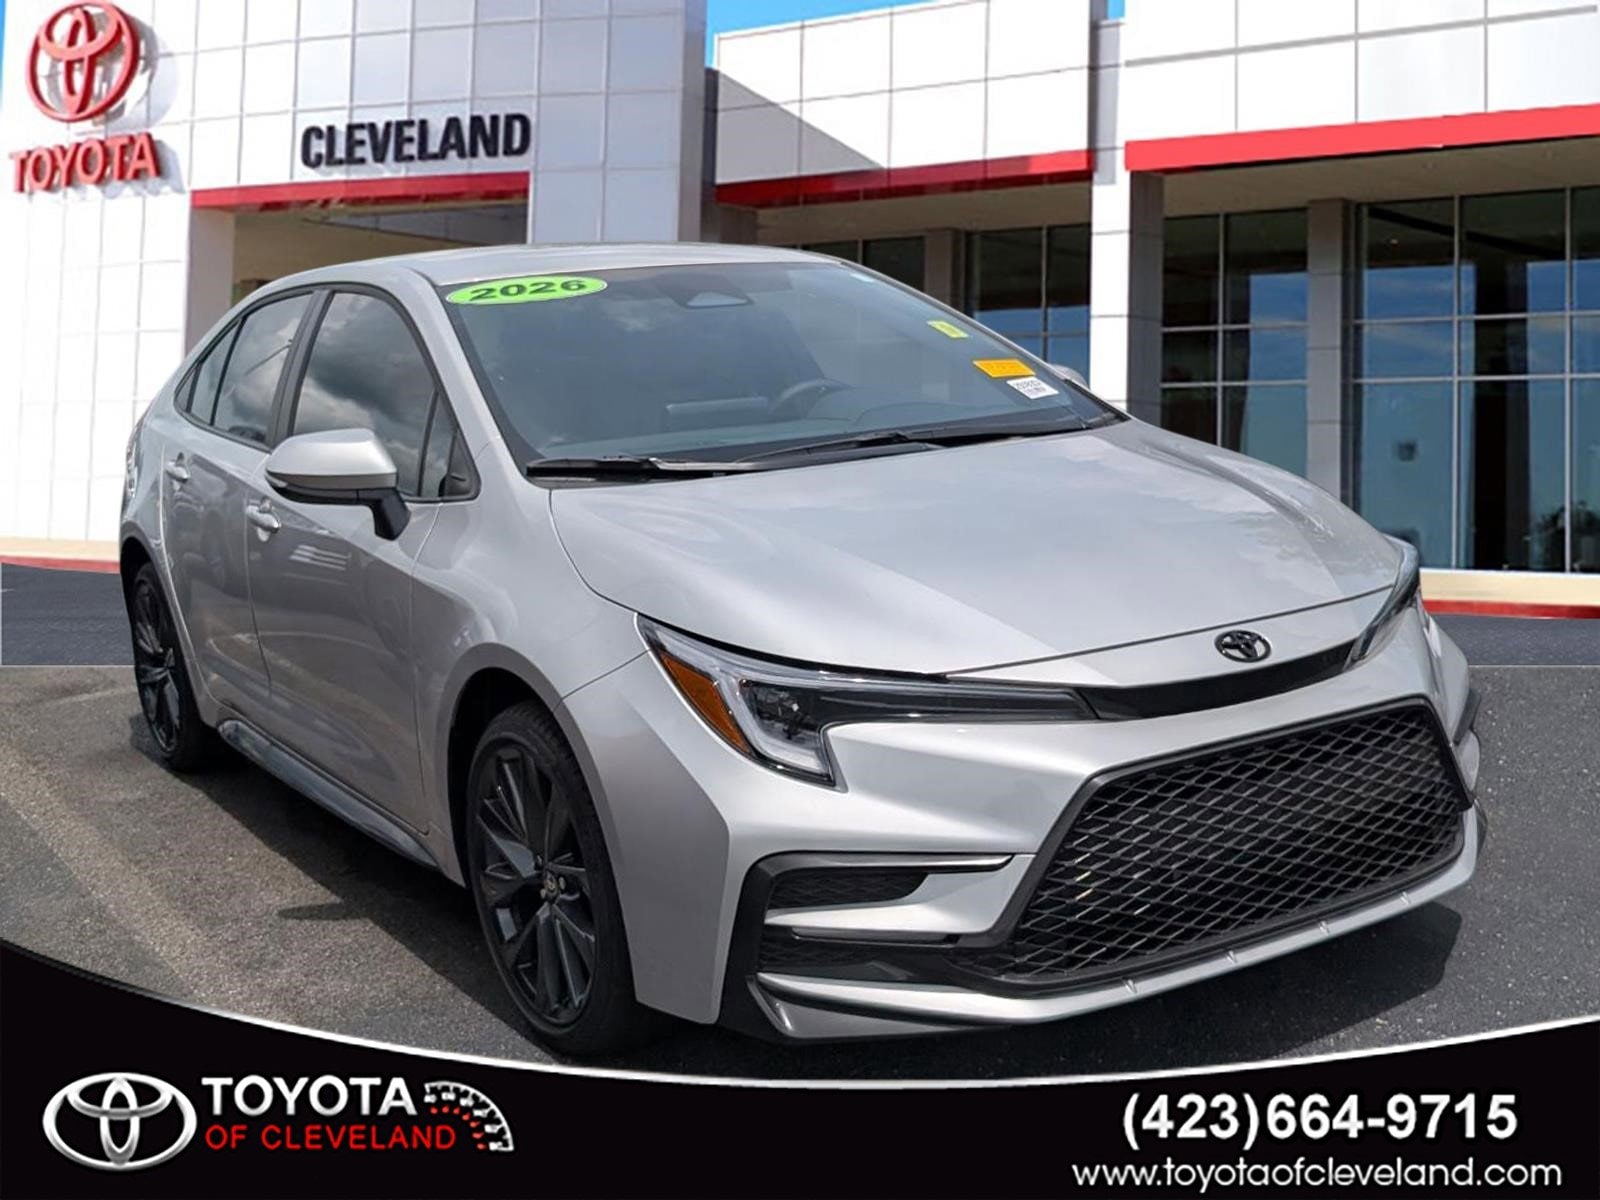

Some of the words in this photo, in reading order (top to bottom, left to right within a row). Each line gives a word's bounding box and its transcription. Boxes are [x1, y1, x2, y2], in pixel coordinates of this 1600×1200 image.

[9, 132, 162, 193] TOYOTA
[301, 113, 531, 169] CLEVELAND
[469, 279, 587, 301] 2026
